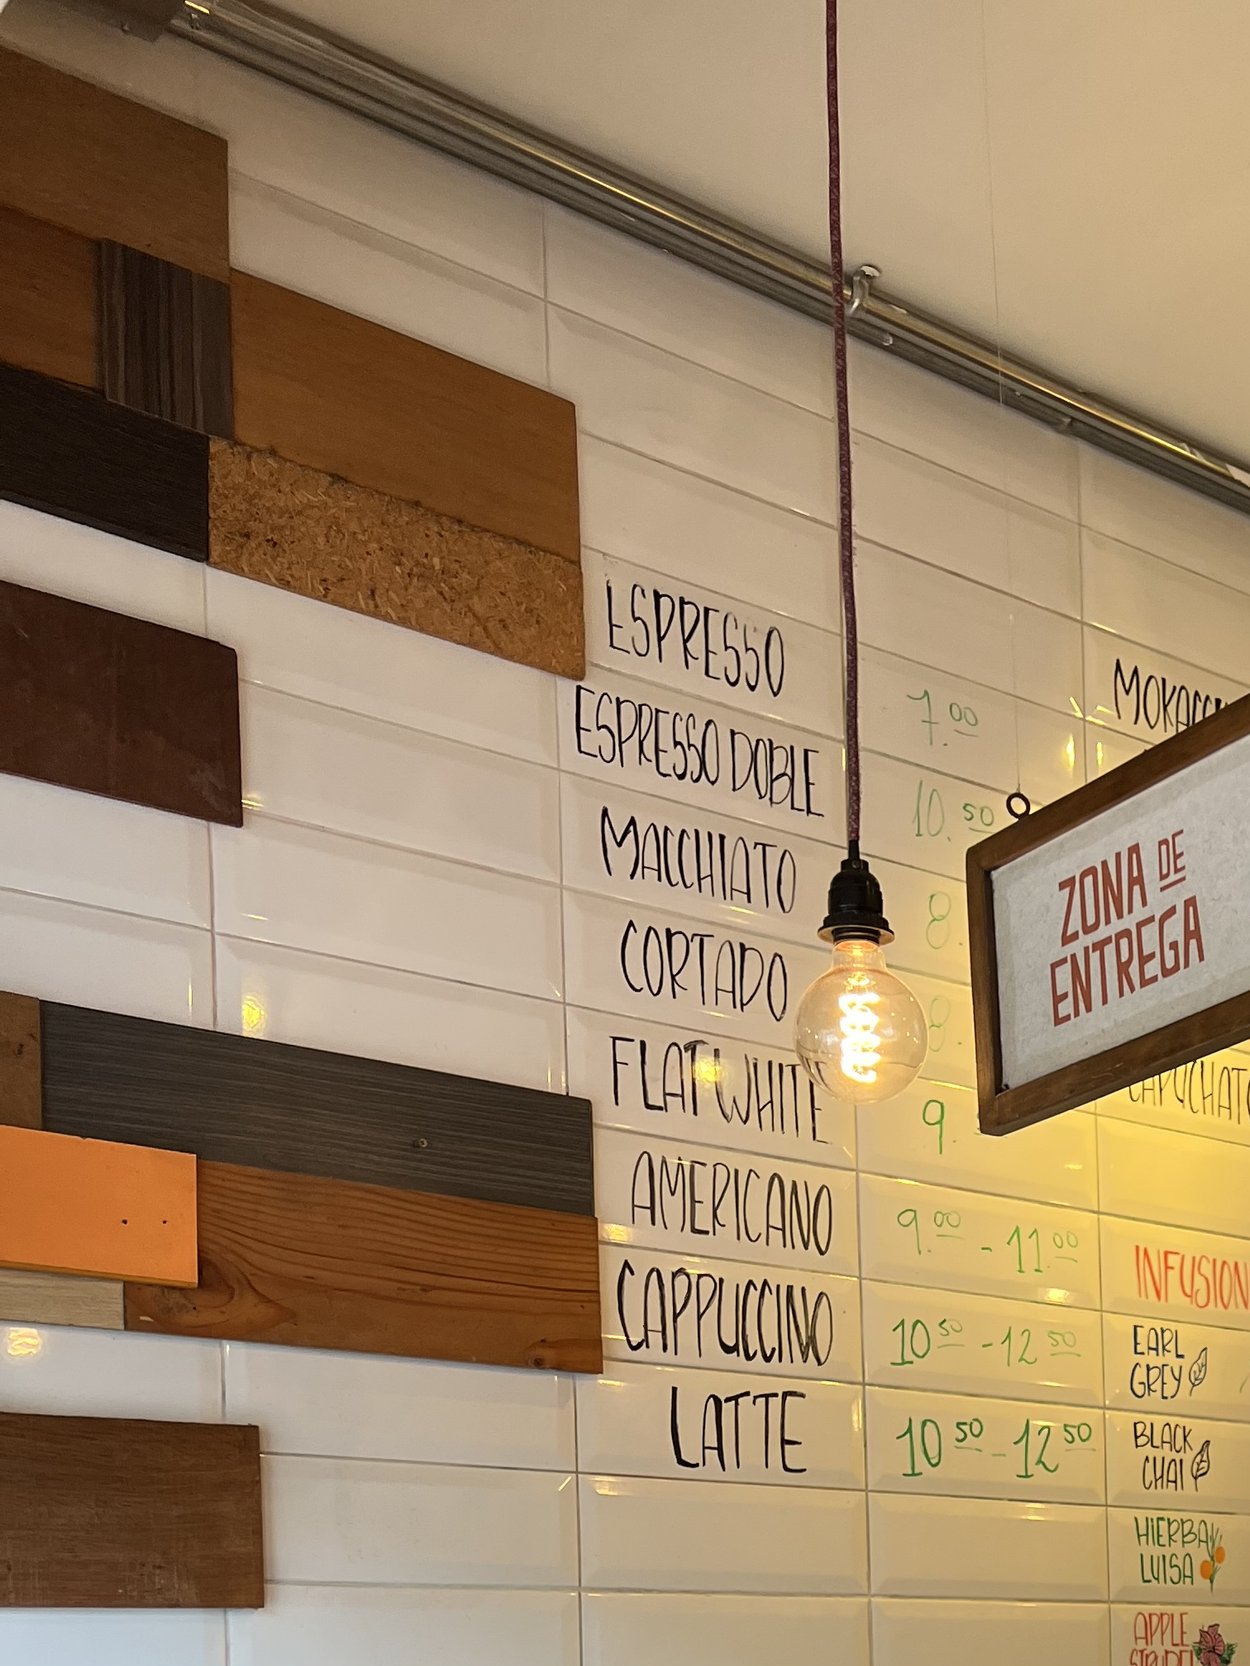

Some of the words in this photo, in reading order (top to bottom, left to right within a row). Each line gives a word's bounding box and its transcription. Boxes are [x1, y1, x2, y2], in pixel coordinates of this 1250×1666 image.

[605, 579, 785, 698] ESPRESSO
[574, 684, 720, 787] ESPRESSO
[730, 728, 825, 818] DOBLE
[600, 806, 797, 914] MACCHIATO
[1057, 841, 1148, 948] ZONA
[1157, 829, 1188, 888] DE
[620, 920, 787, 1022] CORTADO
[1049, 895, 1205, 1028] ENTREGA
[609, 1036, 708, 1117] FLAT
[714, 1048, 832, 1145] WHITE
[631, 1151, 833, 1257] AMERICANO
[617, 1259, 834, 1367] CAPPUCCINO
[1133, 1325, 1186, 1360] EARL
[670, 1385, 808, 1474] LATTE
[1130, 1362, 1182, 1400] GREY
[1134, 1421, 1194, 1453] BLACK
[1142, 1454, 1185, 1491] CHAI
[1134, 1516, 1210, 1549] HIERBA
[1140, 1552, 1194, 1586] LUISA
[1134, 1612, 1189, 1646] APPLE
